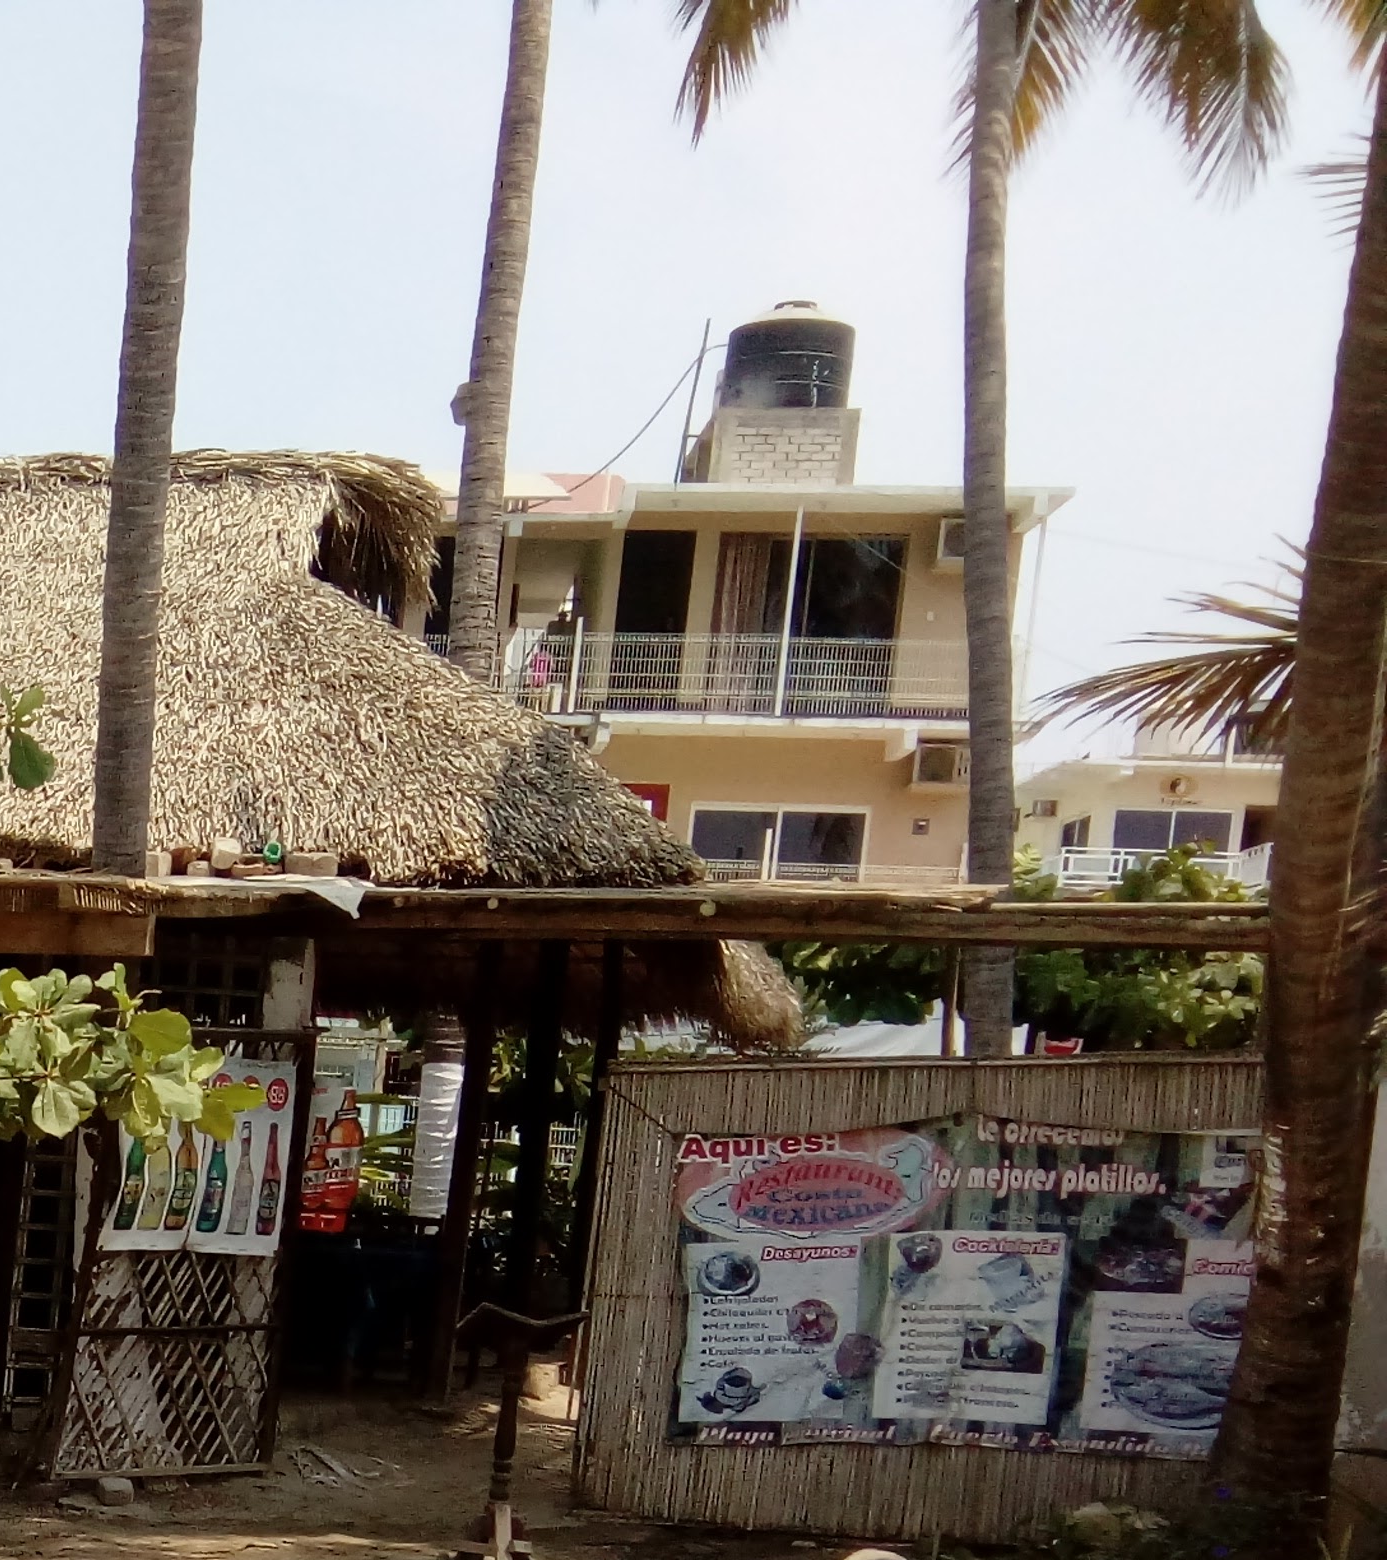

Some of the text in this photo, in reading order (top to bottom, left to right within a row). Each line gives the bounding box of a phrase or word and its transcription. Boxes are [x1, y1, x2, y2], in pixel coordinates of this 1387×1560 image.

[932, 1160, 1167, 1199] los mejores platillos.
